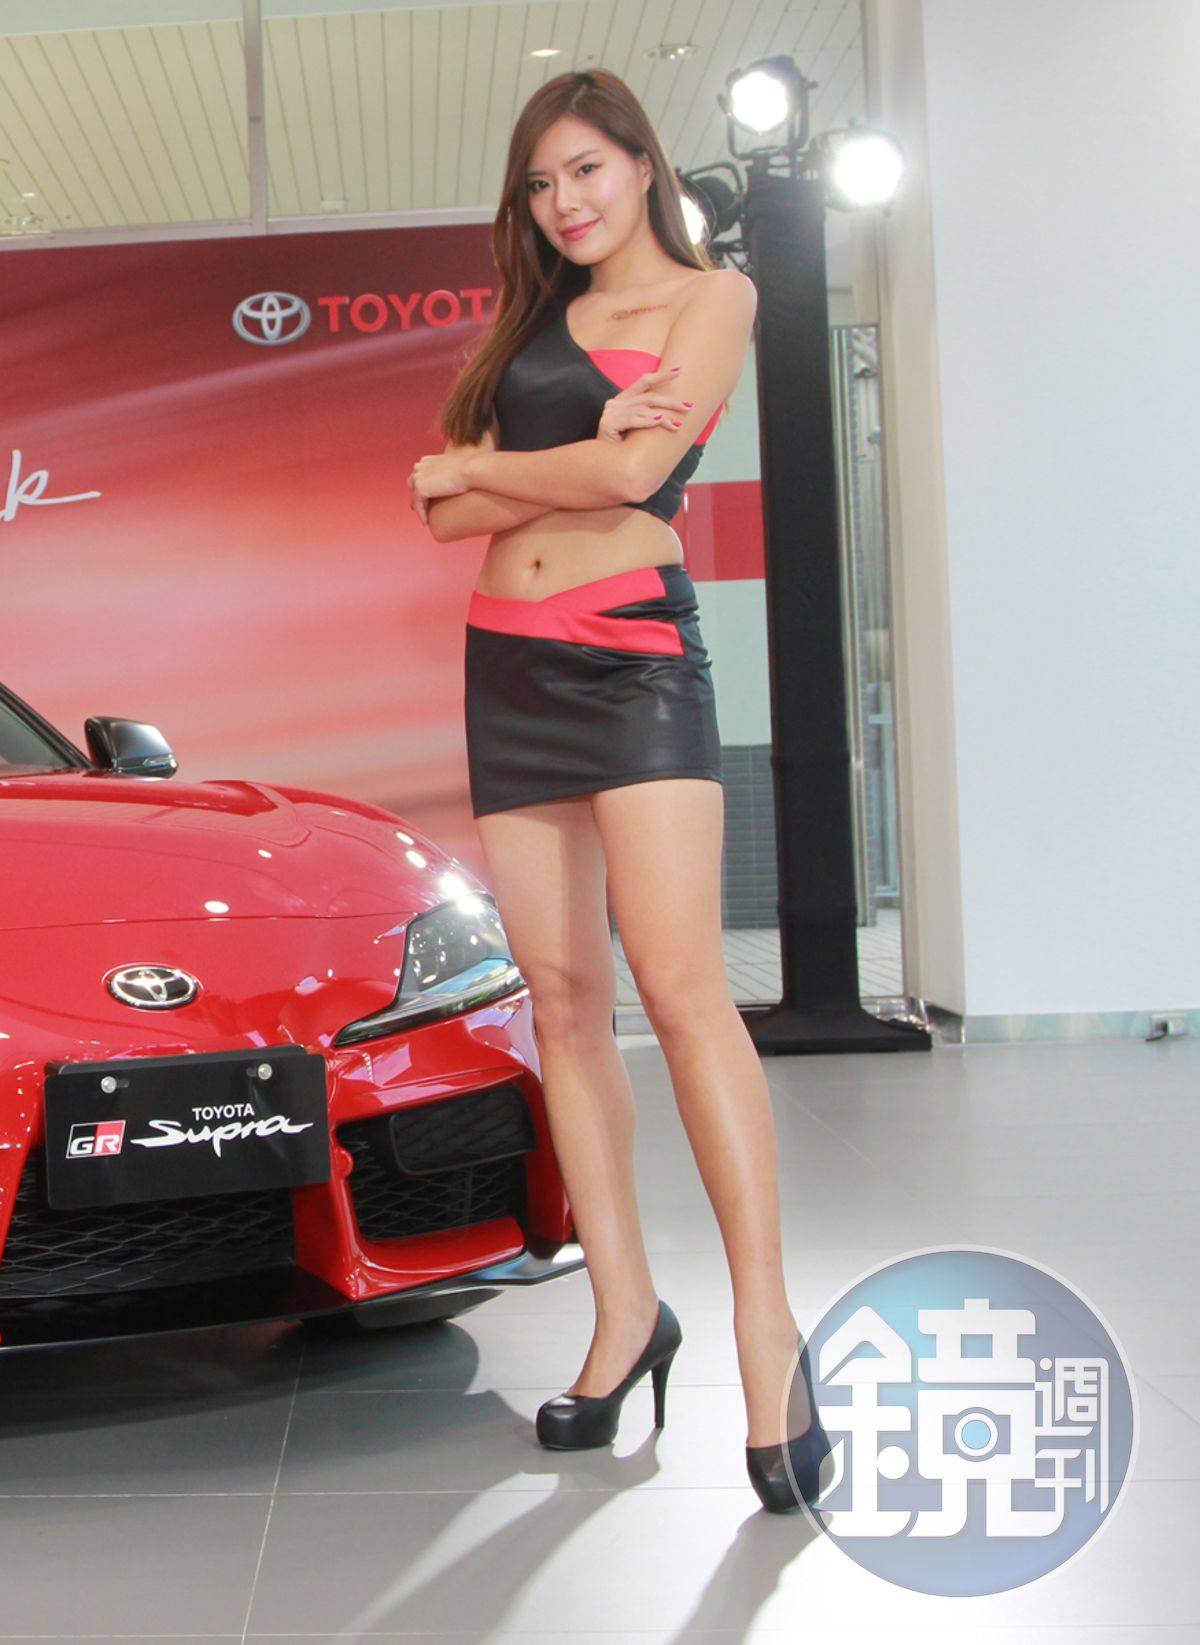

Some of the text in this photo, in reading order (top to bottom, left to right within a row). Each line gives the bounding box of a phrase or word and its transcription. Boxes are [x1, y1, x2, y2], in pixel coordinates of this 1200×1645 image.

[317, 287, 499, 333] TOYOT
[192, 1103, 255, 1122] TOYOTA
[69, 1134, 121, 1155] GR
[130, 1114, 314, 1158] Supra
